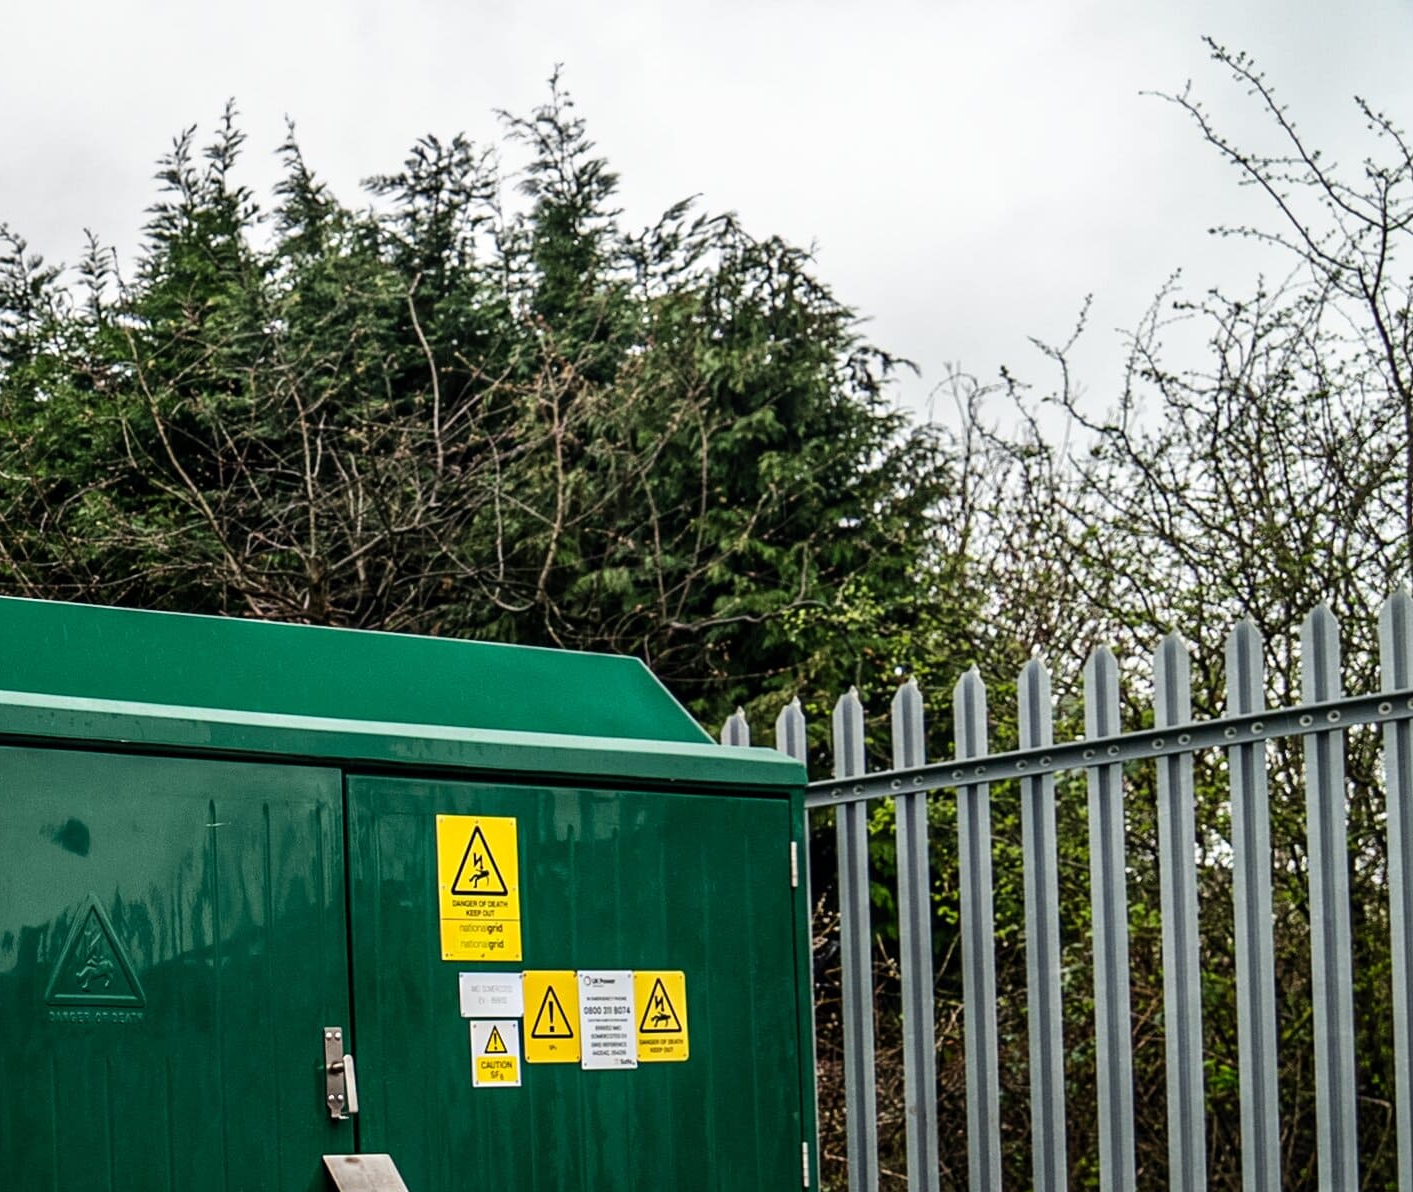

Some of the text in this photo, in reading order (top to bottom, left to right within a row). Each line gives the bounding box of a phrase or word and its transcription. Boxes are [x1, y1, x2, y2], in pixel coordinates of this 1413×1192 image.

[452, 899, 478, 907] DANGER
[488, 900, 508, 908] DEATH
[466, 909, 495, 917] KEEP OUT
[481, 1060, 513, 1069] CAUTION
